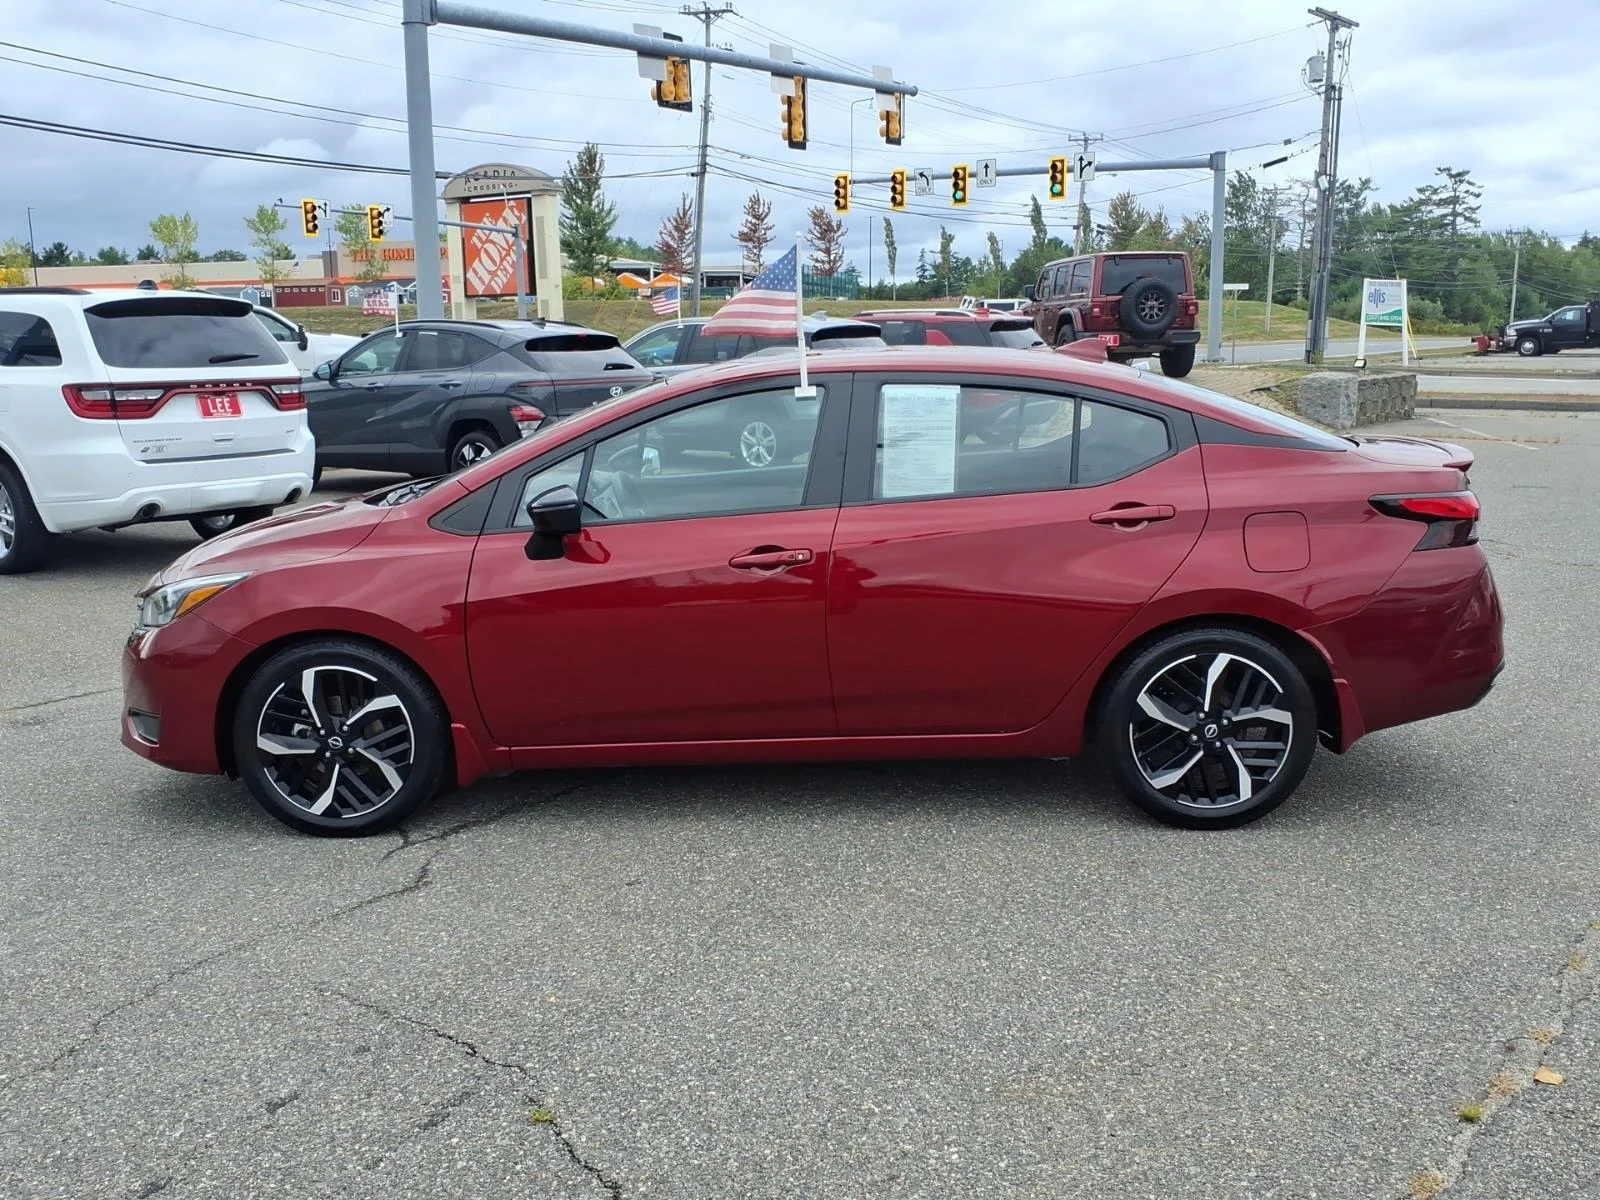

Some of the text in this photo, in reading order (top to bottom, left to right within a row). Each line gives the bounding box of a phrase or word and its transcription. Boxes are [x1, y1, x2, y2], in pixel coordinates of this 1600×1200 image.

[979, 178, 993, 186] ONLY
[466, 200, 528, 295] HOME
[207, 398, 233, 413] LEE
